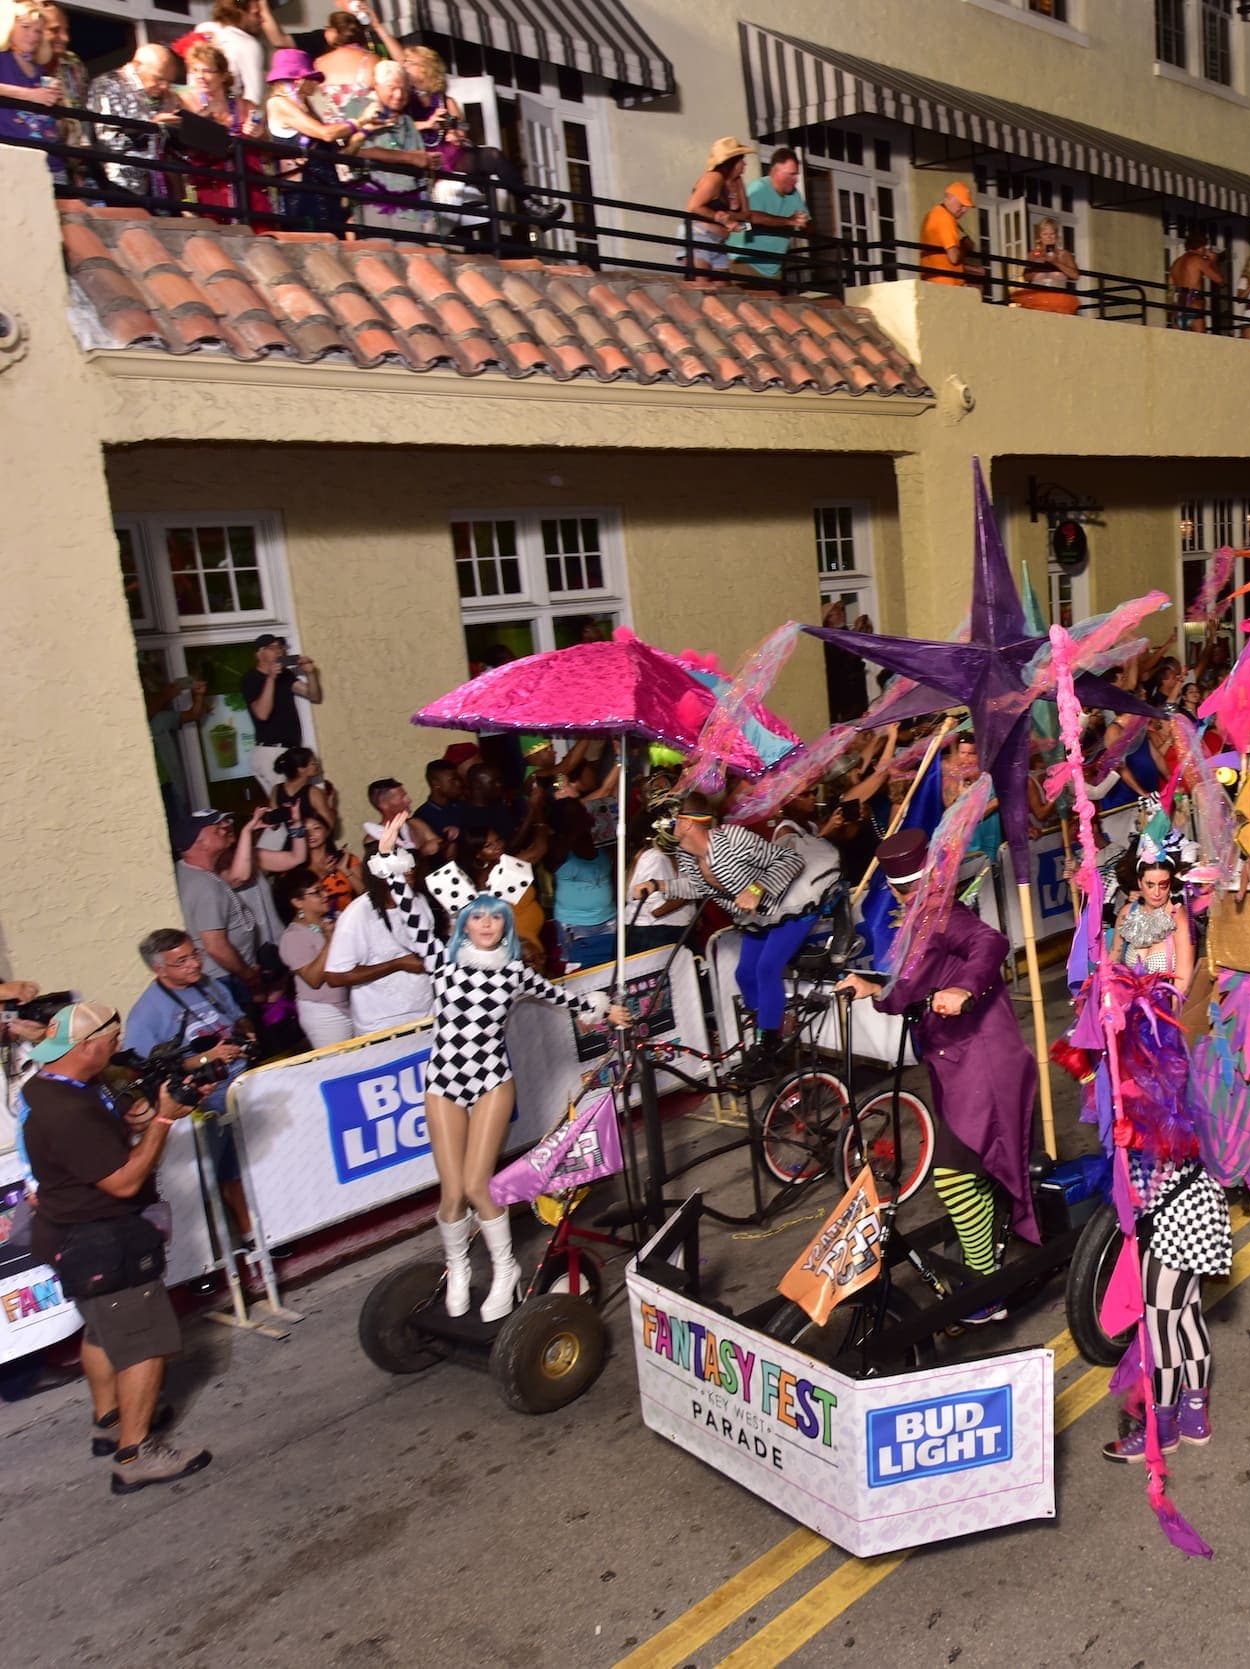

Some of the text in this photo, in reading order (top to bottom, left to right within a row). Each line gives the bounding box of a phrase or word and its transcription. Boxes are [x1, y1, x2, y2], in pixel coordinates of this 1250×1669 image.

[358, 1061, 427, 1121] BU
[342, 1105, 431, 1170] LIG
[641, 1300, 837, 1447] FANTASY FEST
[692, 1400, 783, 1470] PARADE
[708, 1391, 765, 1434] KEY WEST
[895, 1402, 985, 1443] BUD
[878, 1425, 1001, 1477] LIGHT
